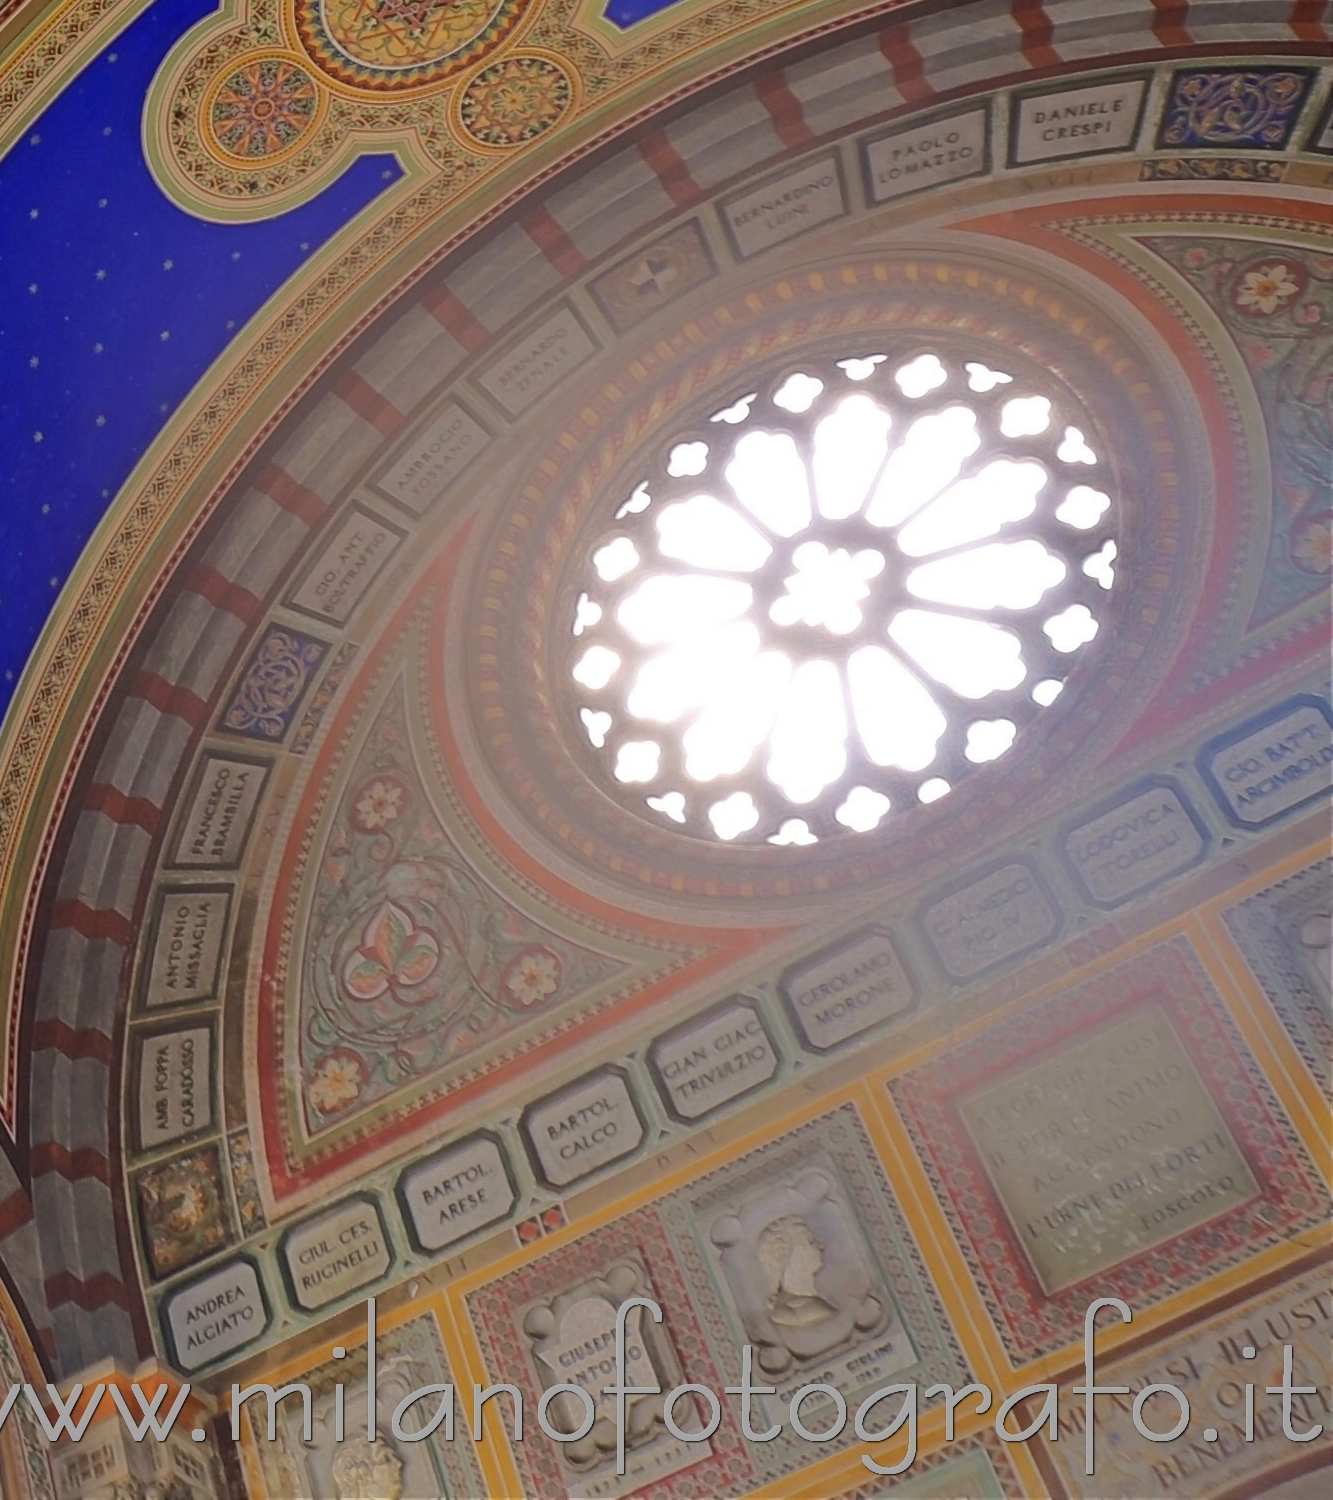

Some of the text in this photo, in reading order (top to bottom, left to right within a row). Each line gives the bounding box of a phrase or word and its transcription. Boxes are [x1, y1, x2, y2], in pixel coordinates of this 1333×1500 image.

[1033, 100, 1124, 125] DANIELE
[1042, 119, 1111, 142] CRESPI
[877, 145, 974, 185] LOMAZZO
[891, 131, 961, 161] PAOLO
[733, 174, 834, 229] BERNARDINO
[766, 205, 809, 231] LUINI
[498, 327, 568, 387] BERNARDO
[411, 433, 473, 496] FOSSANO
[191, 767, 231, 856] FRANCESCO
[211, 771, 251, 856] BRAMBILLA
[166, 905, 191, 990] ANTONIO
[815, 977, 896, 1027] MORONE
[156, 1045, 170, 1092] FOPPA
[182, 1039, 196, 1128] CARADOSSO
[675, 1045, 767, 1100] TRIVULZIO
[1104, 1063, 1184, 1114] ANIMO
[560, 1120, 618, 1160] CALCO
[439, 1188, 488, 1224] ARESE
[1141, 1175, 1235, 1231] FOSCOLO
[302, 1241, 380, 1292] RUGINELLI
[186, 1285, 246, 1325] ANDREA
